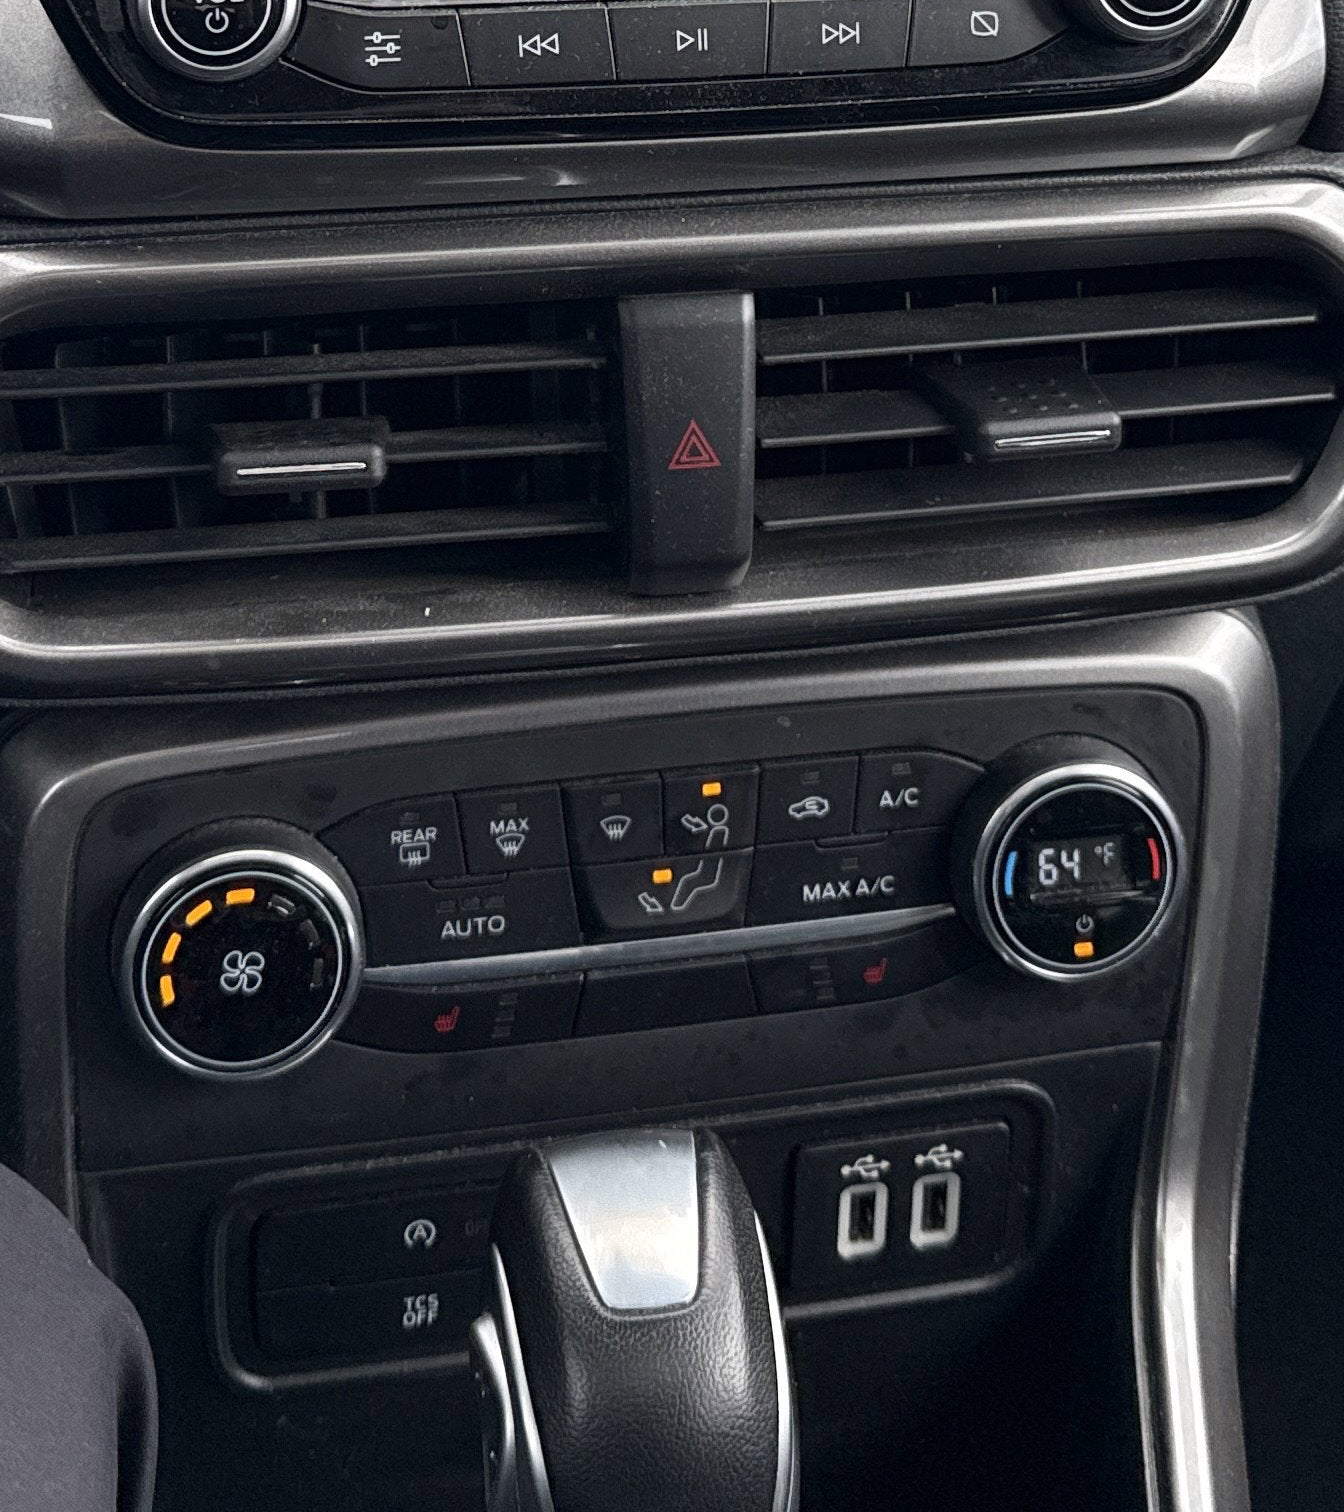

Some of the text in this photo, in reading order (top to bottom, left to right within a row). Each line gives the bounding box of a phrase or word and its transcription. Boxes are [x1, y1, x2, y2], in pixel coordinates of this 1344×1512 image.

[879, 787, 919, 808] A/C
[391, 826, 437, 844] REAR
[490, 819, 529, 835] MAX
[1038, 848, 1081, 886] 64
[803, 875, 895, 903] MAX A/C
[441, 914, 505, 939] AUTO
[403, 1293, 438, 1311] TCS
[402, 1309, 438, 1327] OFF
